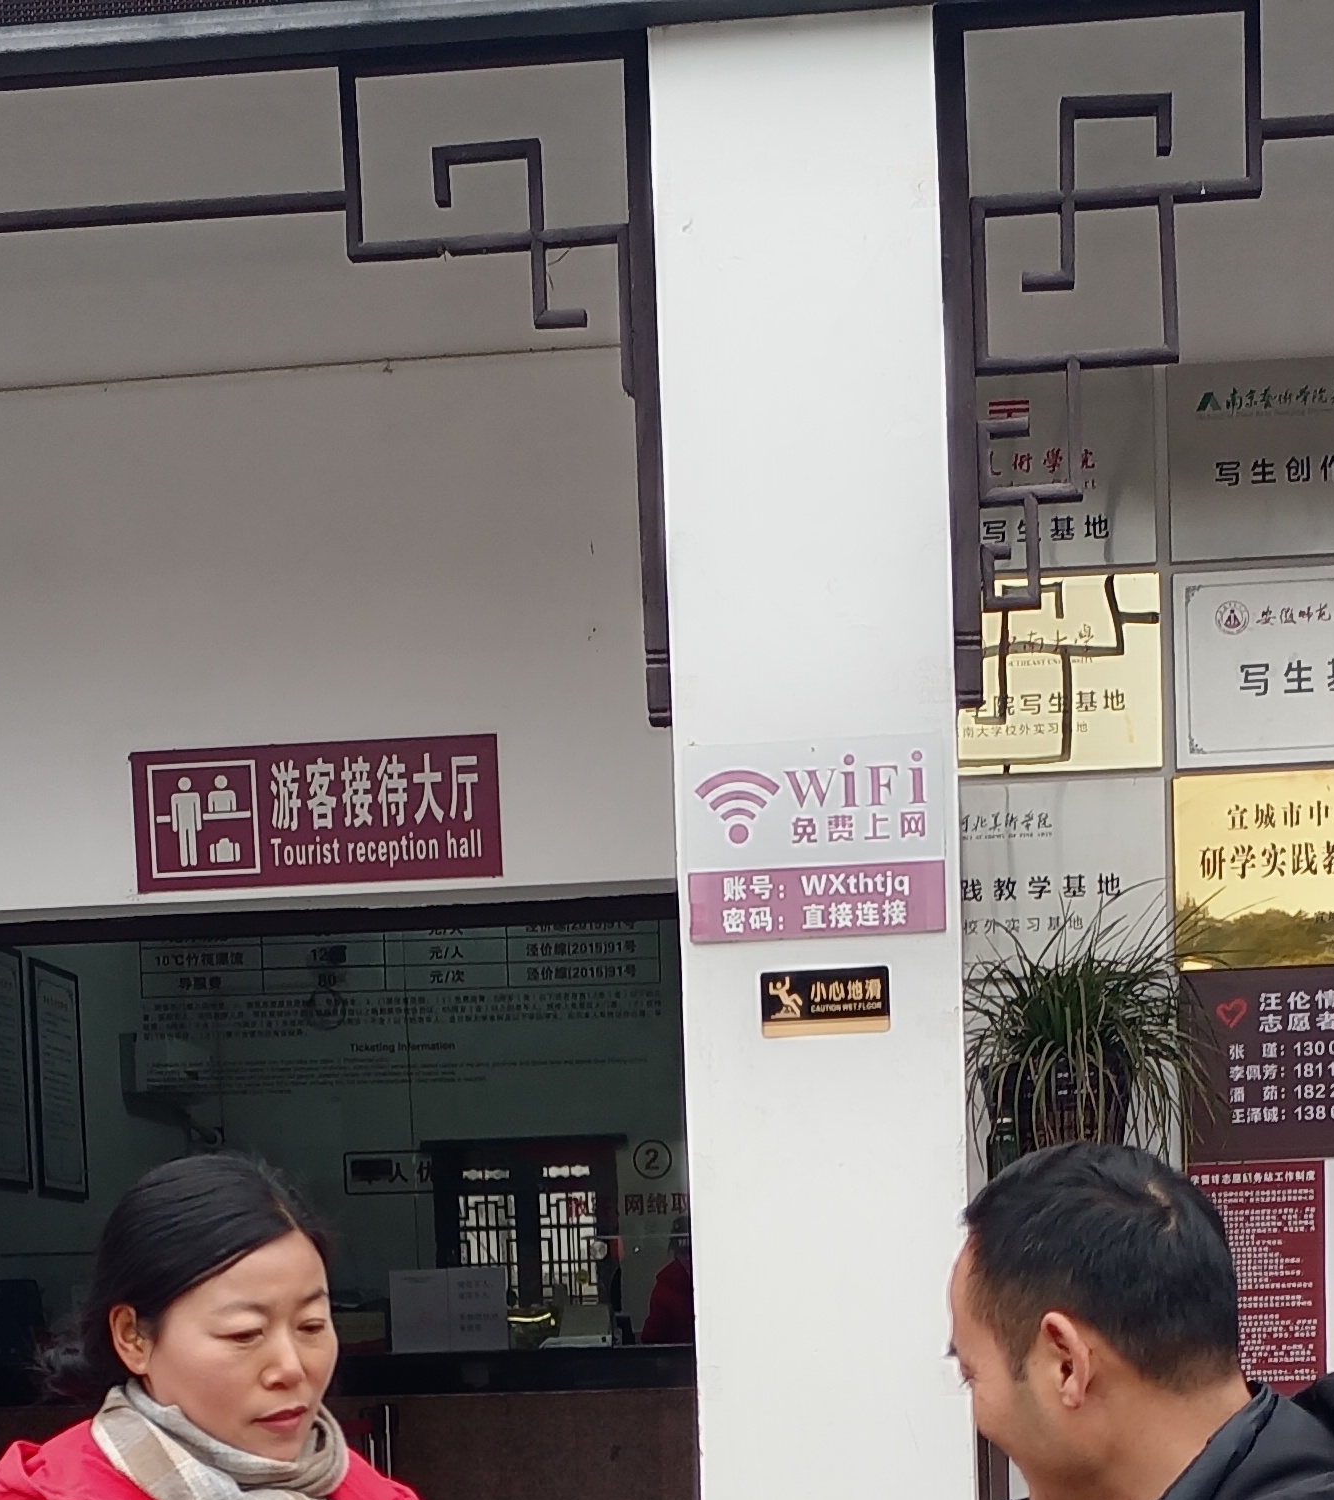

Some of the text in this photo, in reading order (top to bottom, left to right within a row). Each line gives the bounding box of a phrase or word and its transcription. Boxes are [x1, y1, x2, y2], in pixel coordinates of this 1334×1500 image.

[270, 753, 479, 832] 游客接待大厅
[784, 750, 927, 809] WiFi
[792, 811, 927, 844] 免费上网
[270, 829, 482, 868] Tourist reception hall
[800, 871, 910, 896] WXthtjq
[811, 979, 881, 1003] 小心地滑
